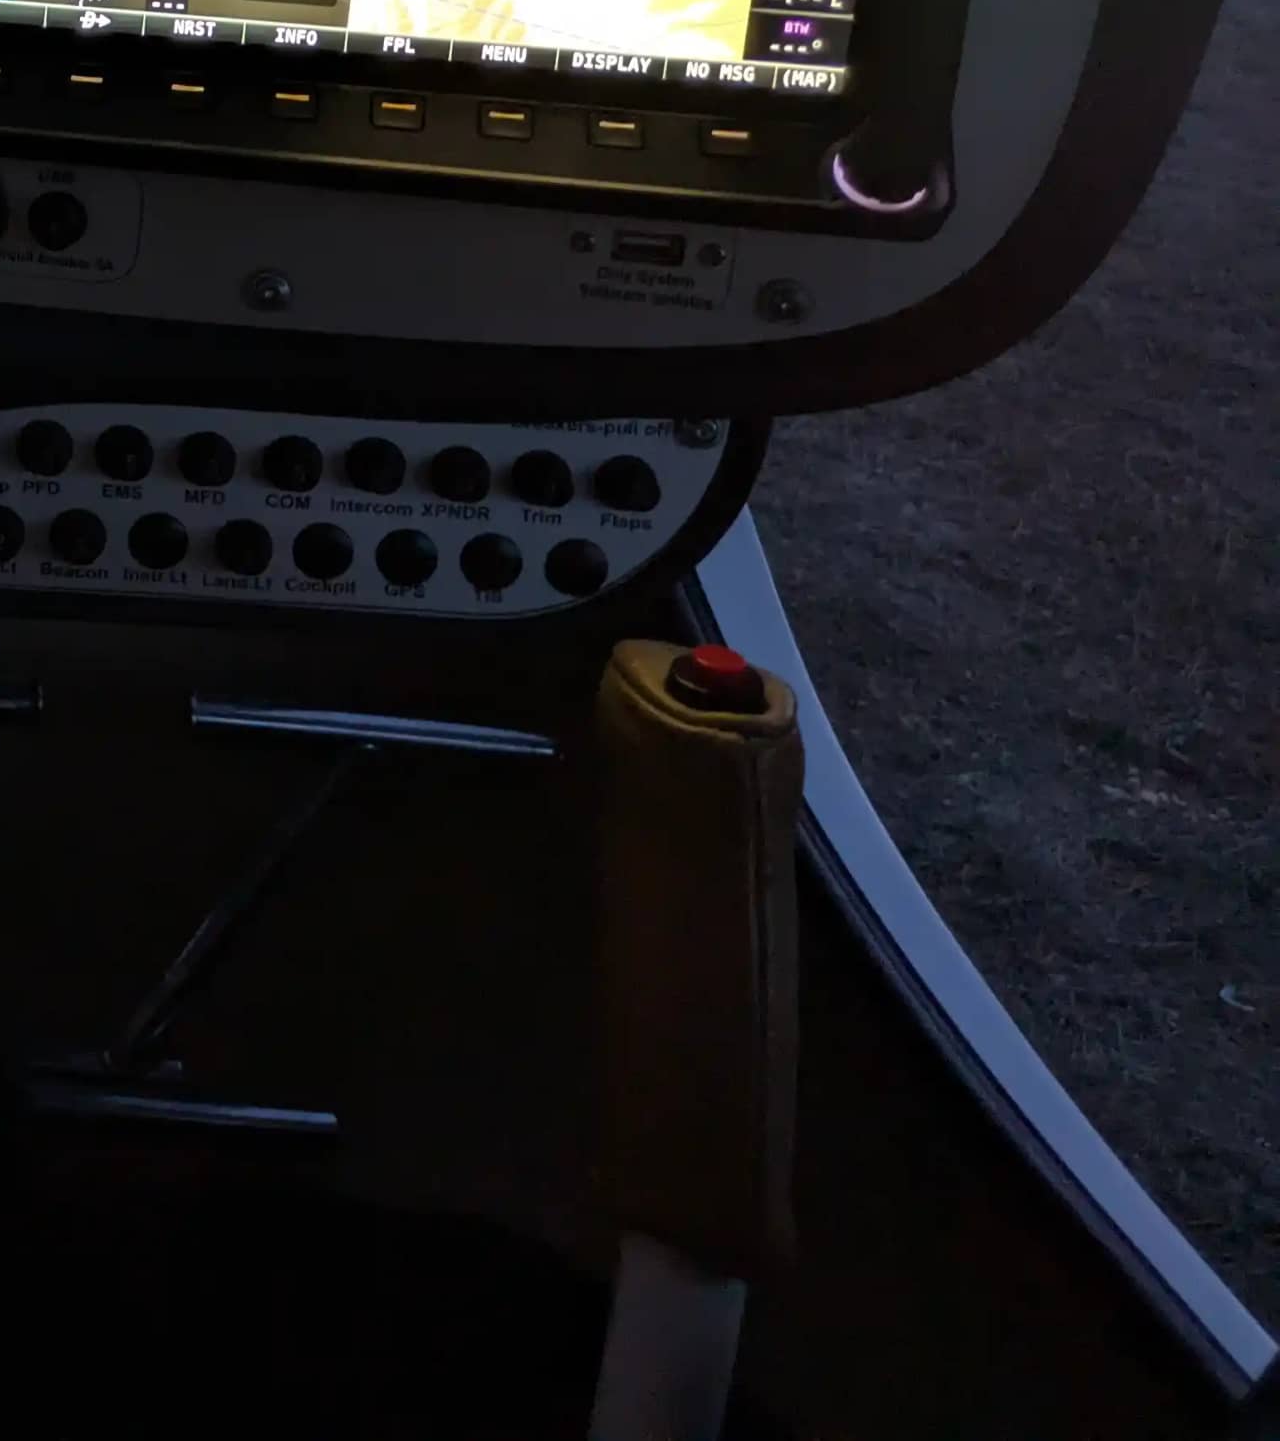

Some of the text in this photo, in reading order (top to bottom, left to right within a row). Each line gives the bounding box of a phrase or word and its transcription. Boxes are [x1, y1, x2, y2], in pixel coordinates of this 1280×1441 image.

[174, 20, 216, 36] NRST
[275, 28, 318, 45] INFO
[383, 38, 415, 54] FPL
[482, 46, 527, 63] MENU
[573, 54, 651, 73] DISPLAY
[686, 63, 755, 82] NO MSG
[783, 71, 836, 91] (MAP)
[102, 484, 142, 500] EMS
[185, 490, 226, 504] MFD
[266, 494, 311, 510] COM
[331, 498, 413, 518] Intercom
[422, 502, 490, 521] XPNDR
[523, 509, 562, 525] Trim
[601, 514, 653, 530] Flaps
[41, 562, 109, 579] Beacon
